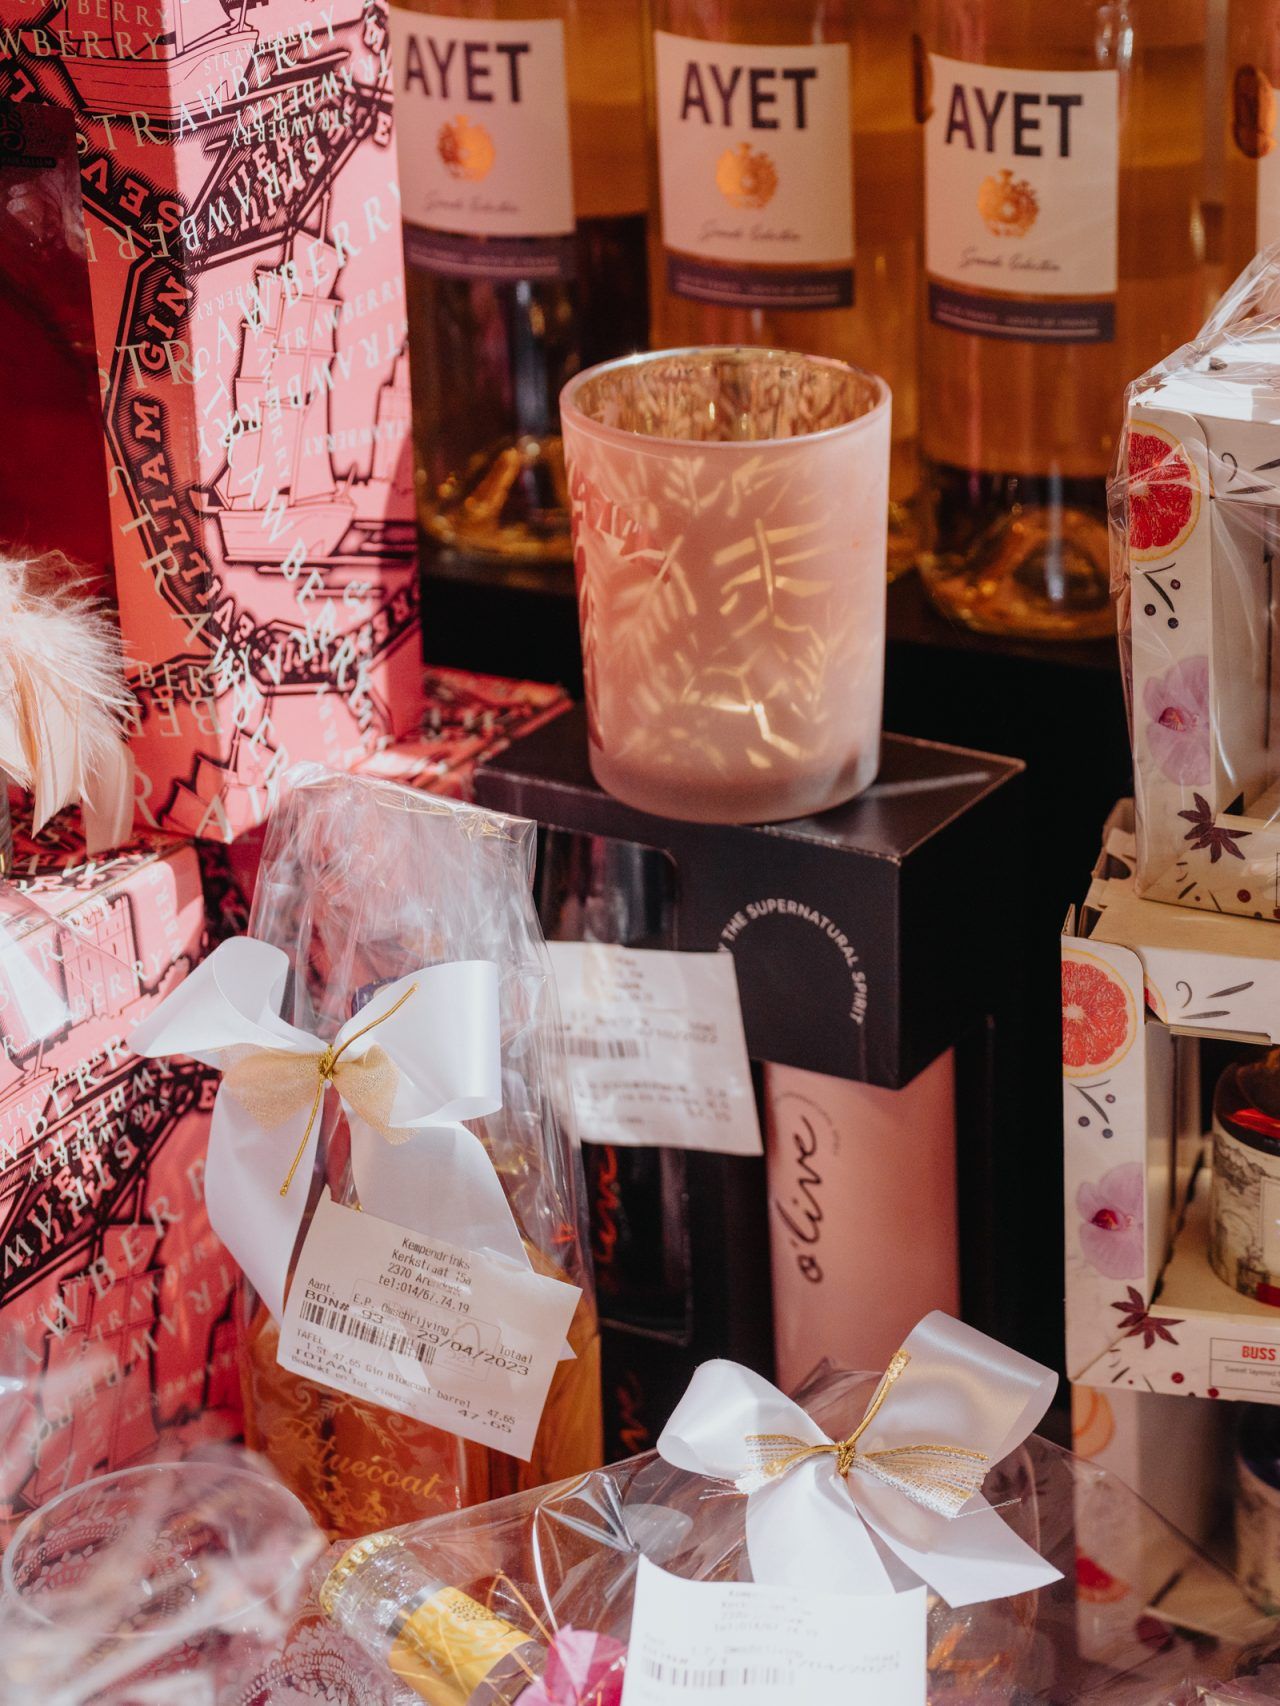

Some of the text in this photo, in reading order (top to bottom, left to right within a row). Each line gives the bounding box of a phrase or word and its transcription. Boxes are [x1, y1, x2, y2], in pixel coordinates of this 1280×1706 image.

[405, 34, 530, 103] AYET
[680, 61, 817, 130] AYET
[945, 84, 1083, 158] AYET
[720, 898, 868, 1026] THE SUPERNATURAL SPIRIT
[387, 1262, 412, 1279] 2370
[402, 1237, 471, 1270] Kempendrinks
[304, 1289, 530, 1376] BON# 93 29/04/2023
[1241, 1345, 1276, 1361] BUSS
[437, 1389, 472, 1408] barrel
